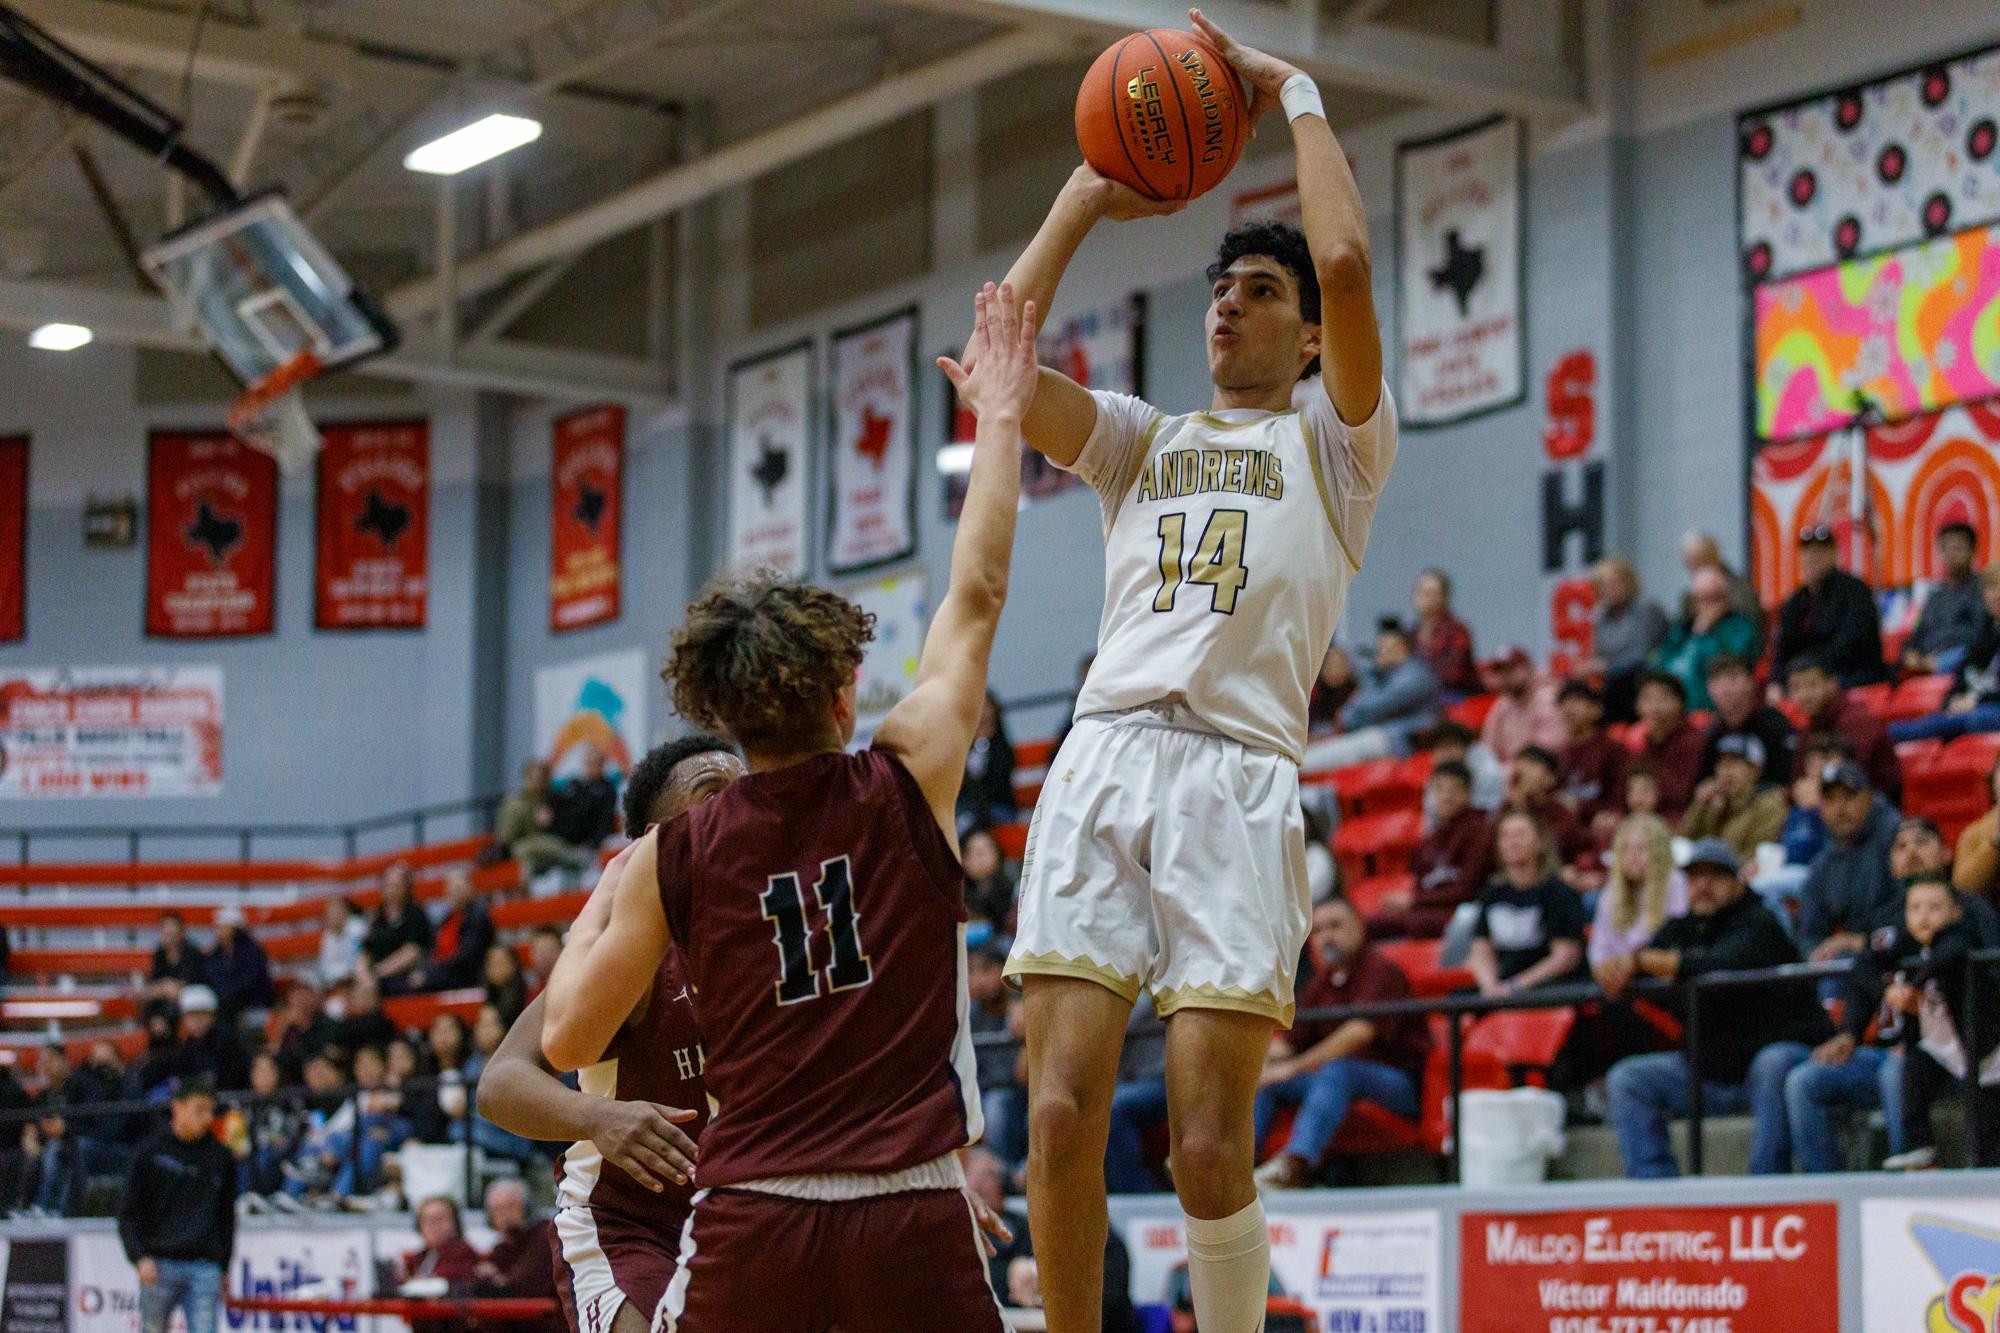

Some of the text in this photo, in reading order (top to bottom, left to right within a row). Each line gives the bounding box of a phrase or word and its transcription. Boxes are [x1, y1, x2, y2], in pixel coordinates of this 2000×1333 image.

[1138, 65, 1176, 165] LEGACY
[1172, 49, 1223, 163] SPALDING
[1137, 449, 1284, 503] ANDREWS
[1152, 508, 1249, 616] 14
[759, 853, 873, 1007] 11
[1730, 1214, 1806, 1262] LLC
[1538, 1276, 1747, 1312] Victor Maldonado
